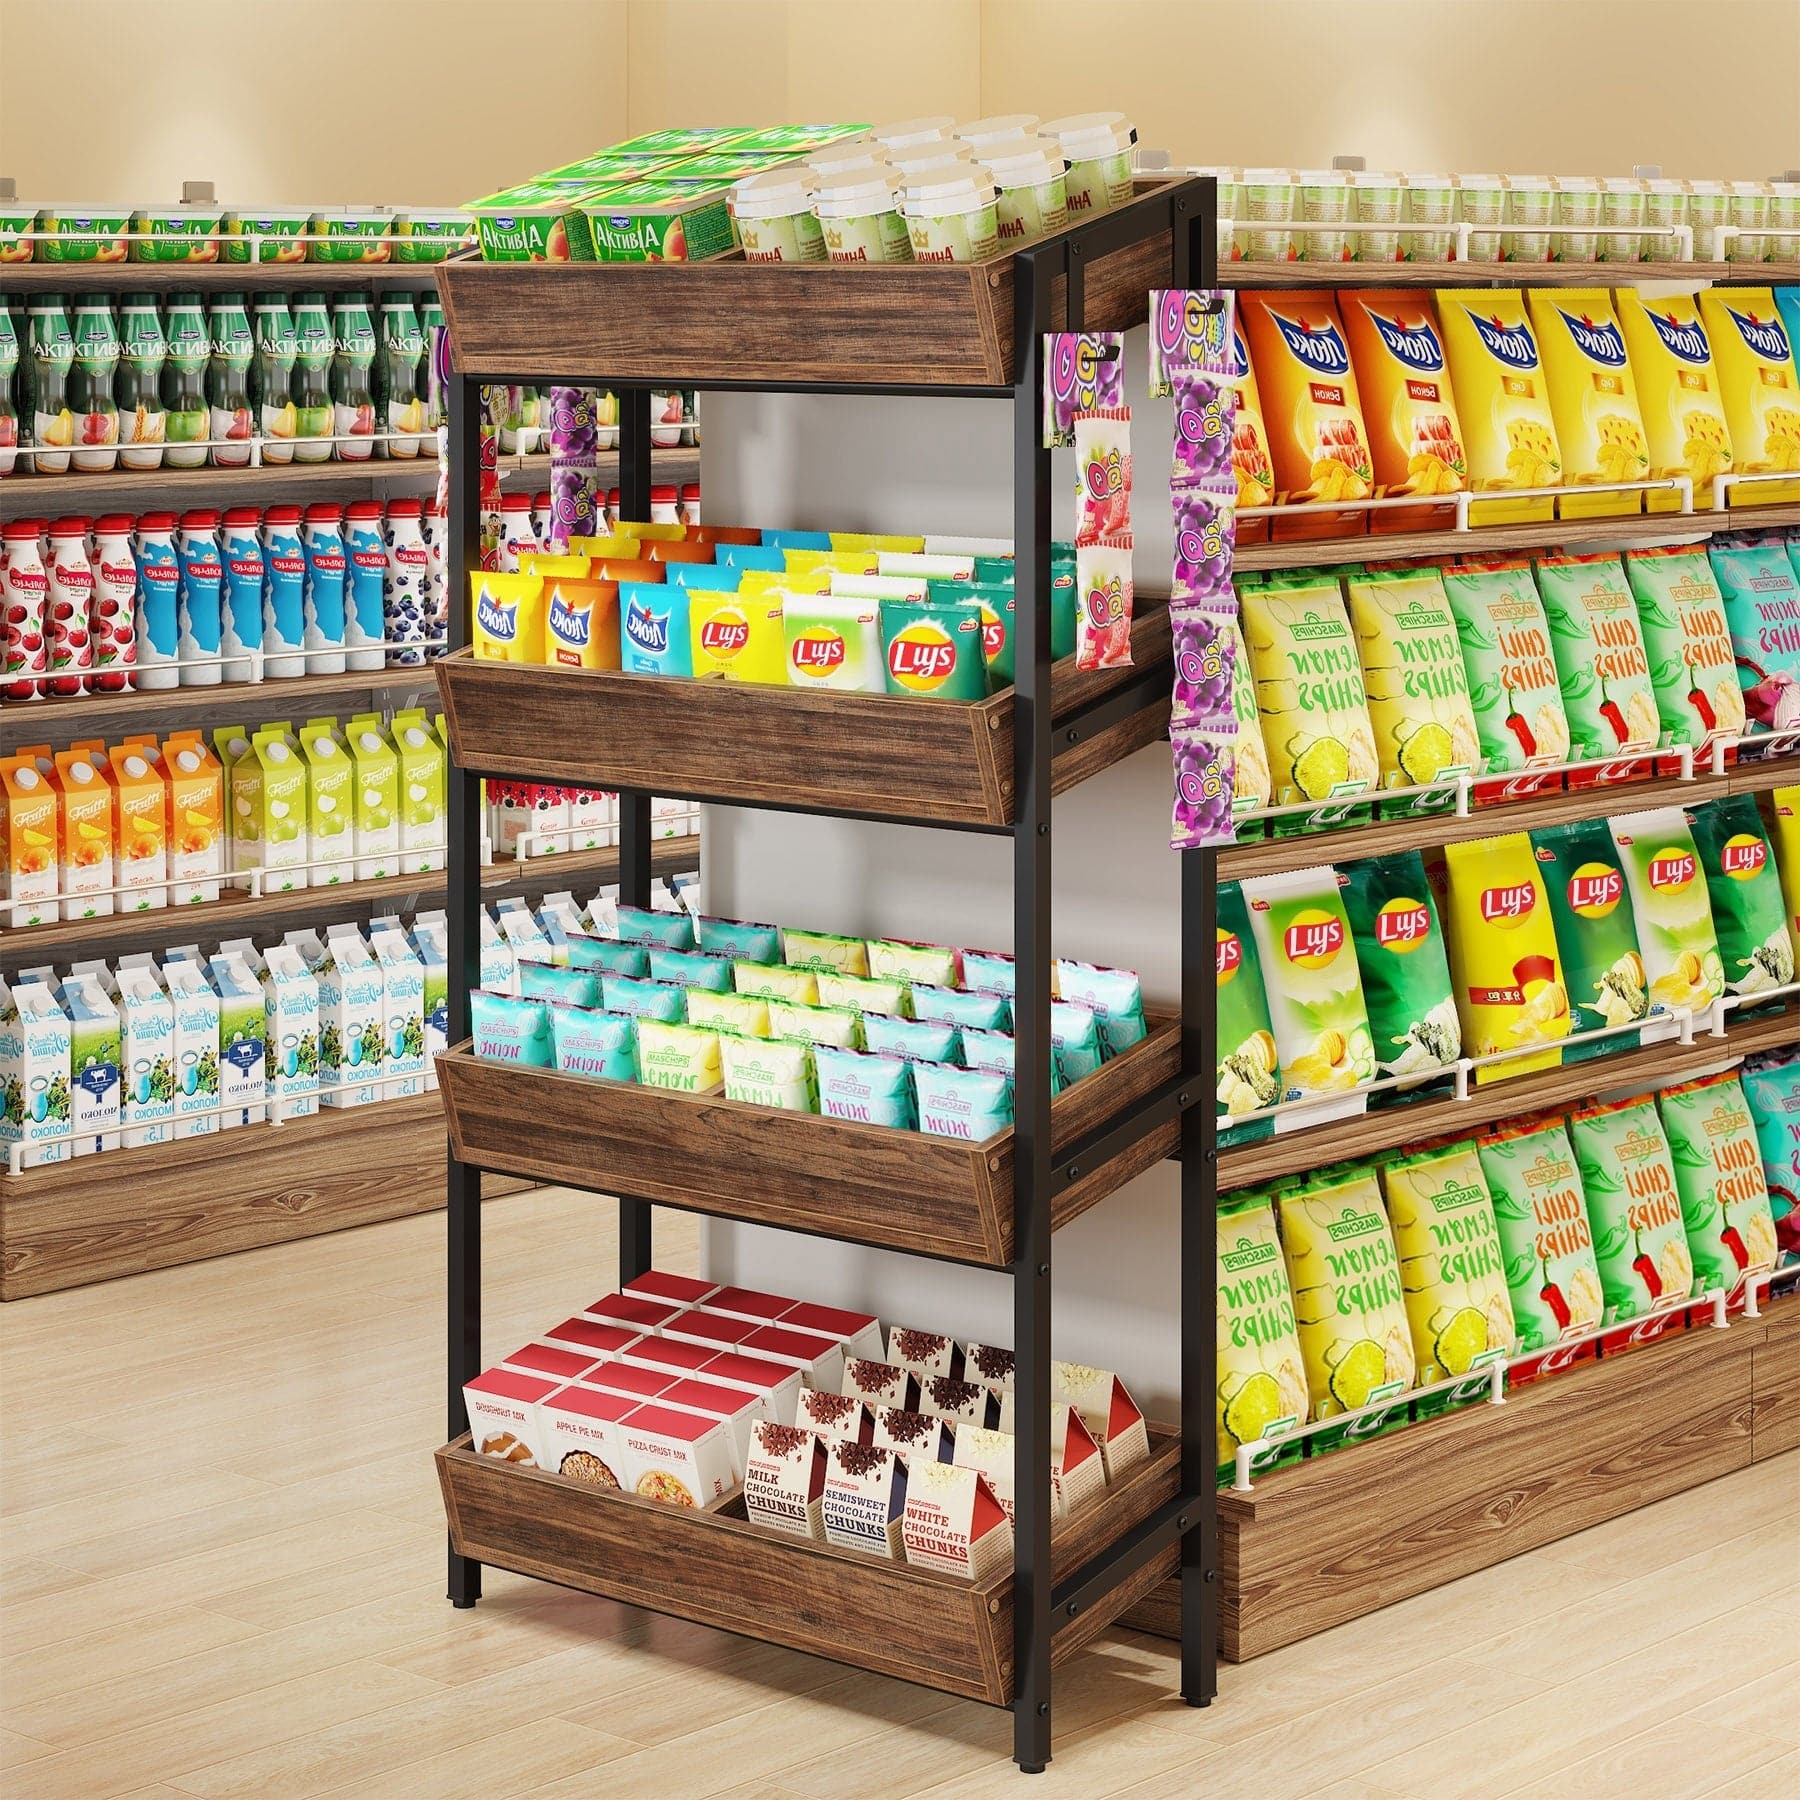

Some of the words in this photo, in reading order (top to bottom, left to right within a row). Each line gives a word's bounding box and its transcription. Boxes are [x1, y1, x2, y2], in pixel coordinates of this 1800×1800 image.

[512, 1410, 526, 1422] MIX
[556, 1421, 578, 1434] APPLE
[579, 1426, 590, 1437] PIE
[591, 1429, 605, 1440] MIX
[628, 1439, 648, 1452] PIZZA
[649, 1444, 672, 1457] CRUST
[673, 1450, 688, 1461] MIX
[748, 1469, 779, 1485] MILK
[746, 1482, 805, 1504] CHOCOLATE
[826, 1489, 886, 1512] SEMISWEET
[747, 1494, 806, 1517] CHUNKS
[824, 1502, 884, 1523] CHOCOLATE
[825, 1513, 885, 1537] CHUNKS
[907, 1508, 949, 1527] WHITE
[905, 1521, 967, 1544] CHOCOLATE
[905, 1534, 968, 1558] CHUNKS
